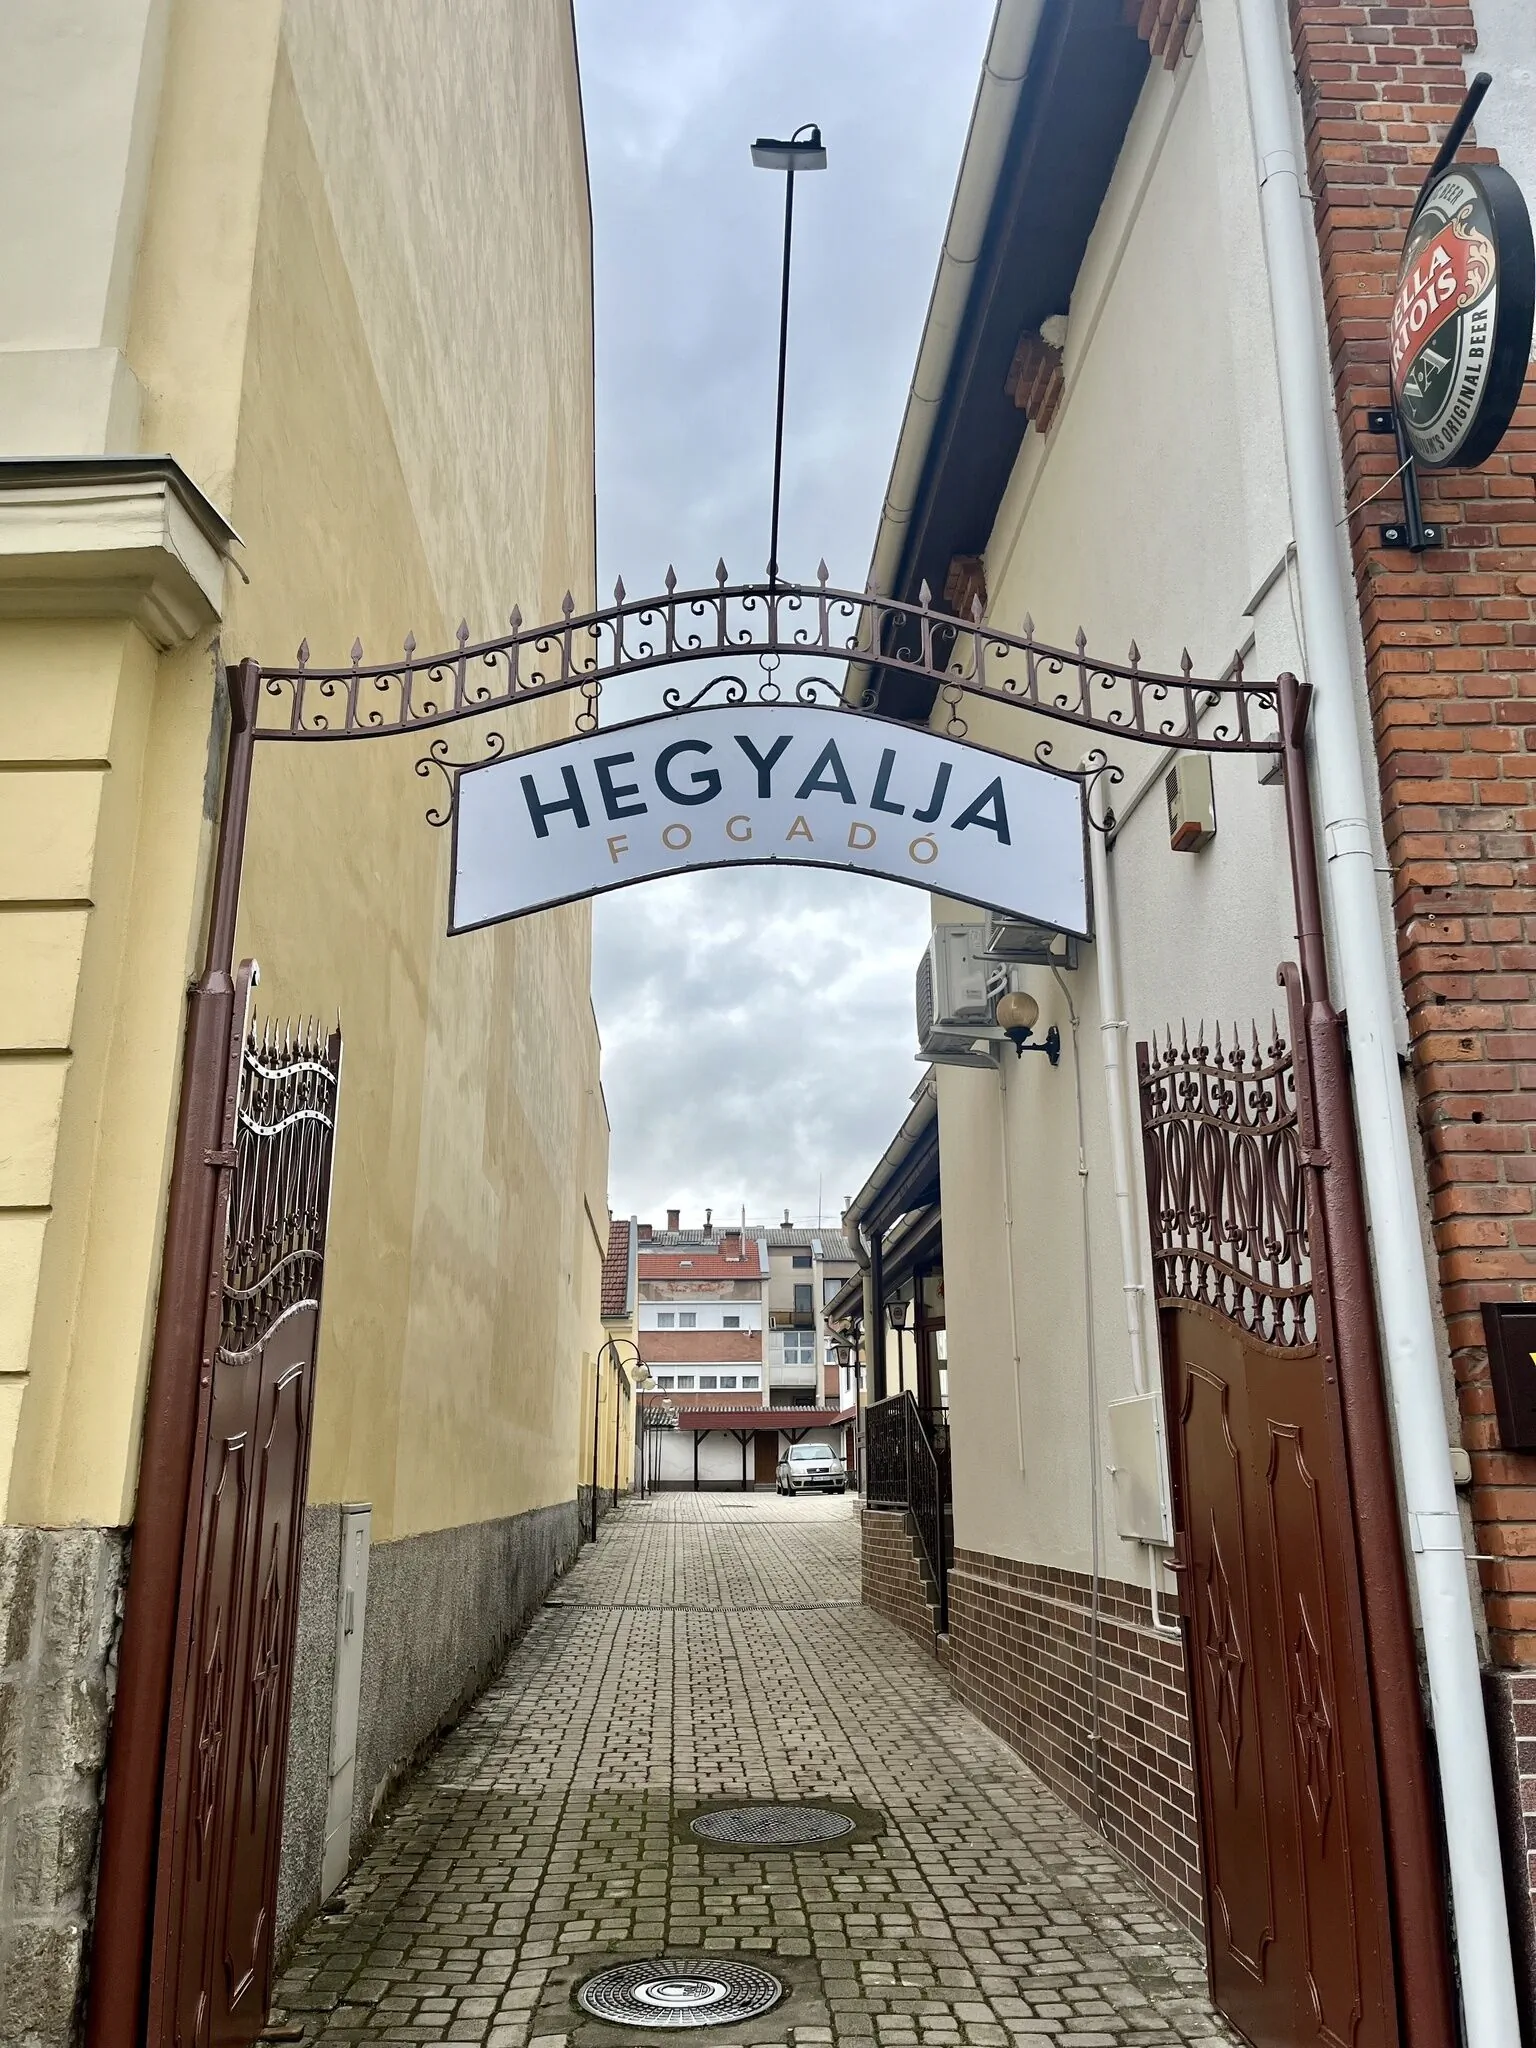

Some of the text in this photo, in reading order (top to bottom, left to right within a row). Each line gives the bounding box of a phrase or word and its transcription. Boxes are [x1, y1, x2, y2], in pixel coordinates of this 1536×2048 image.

[1438, 183, 1464, 205] BEER
[1442, 364, 1482, 443] ORIGINAL
[1469, 309, 1488, 358] BEER
[520, 735, 1012, 846] HEGYALJA
[608, 814, 939, 865] FOGADÓ
